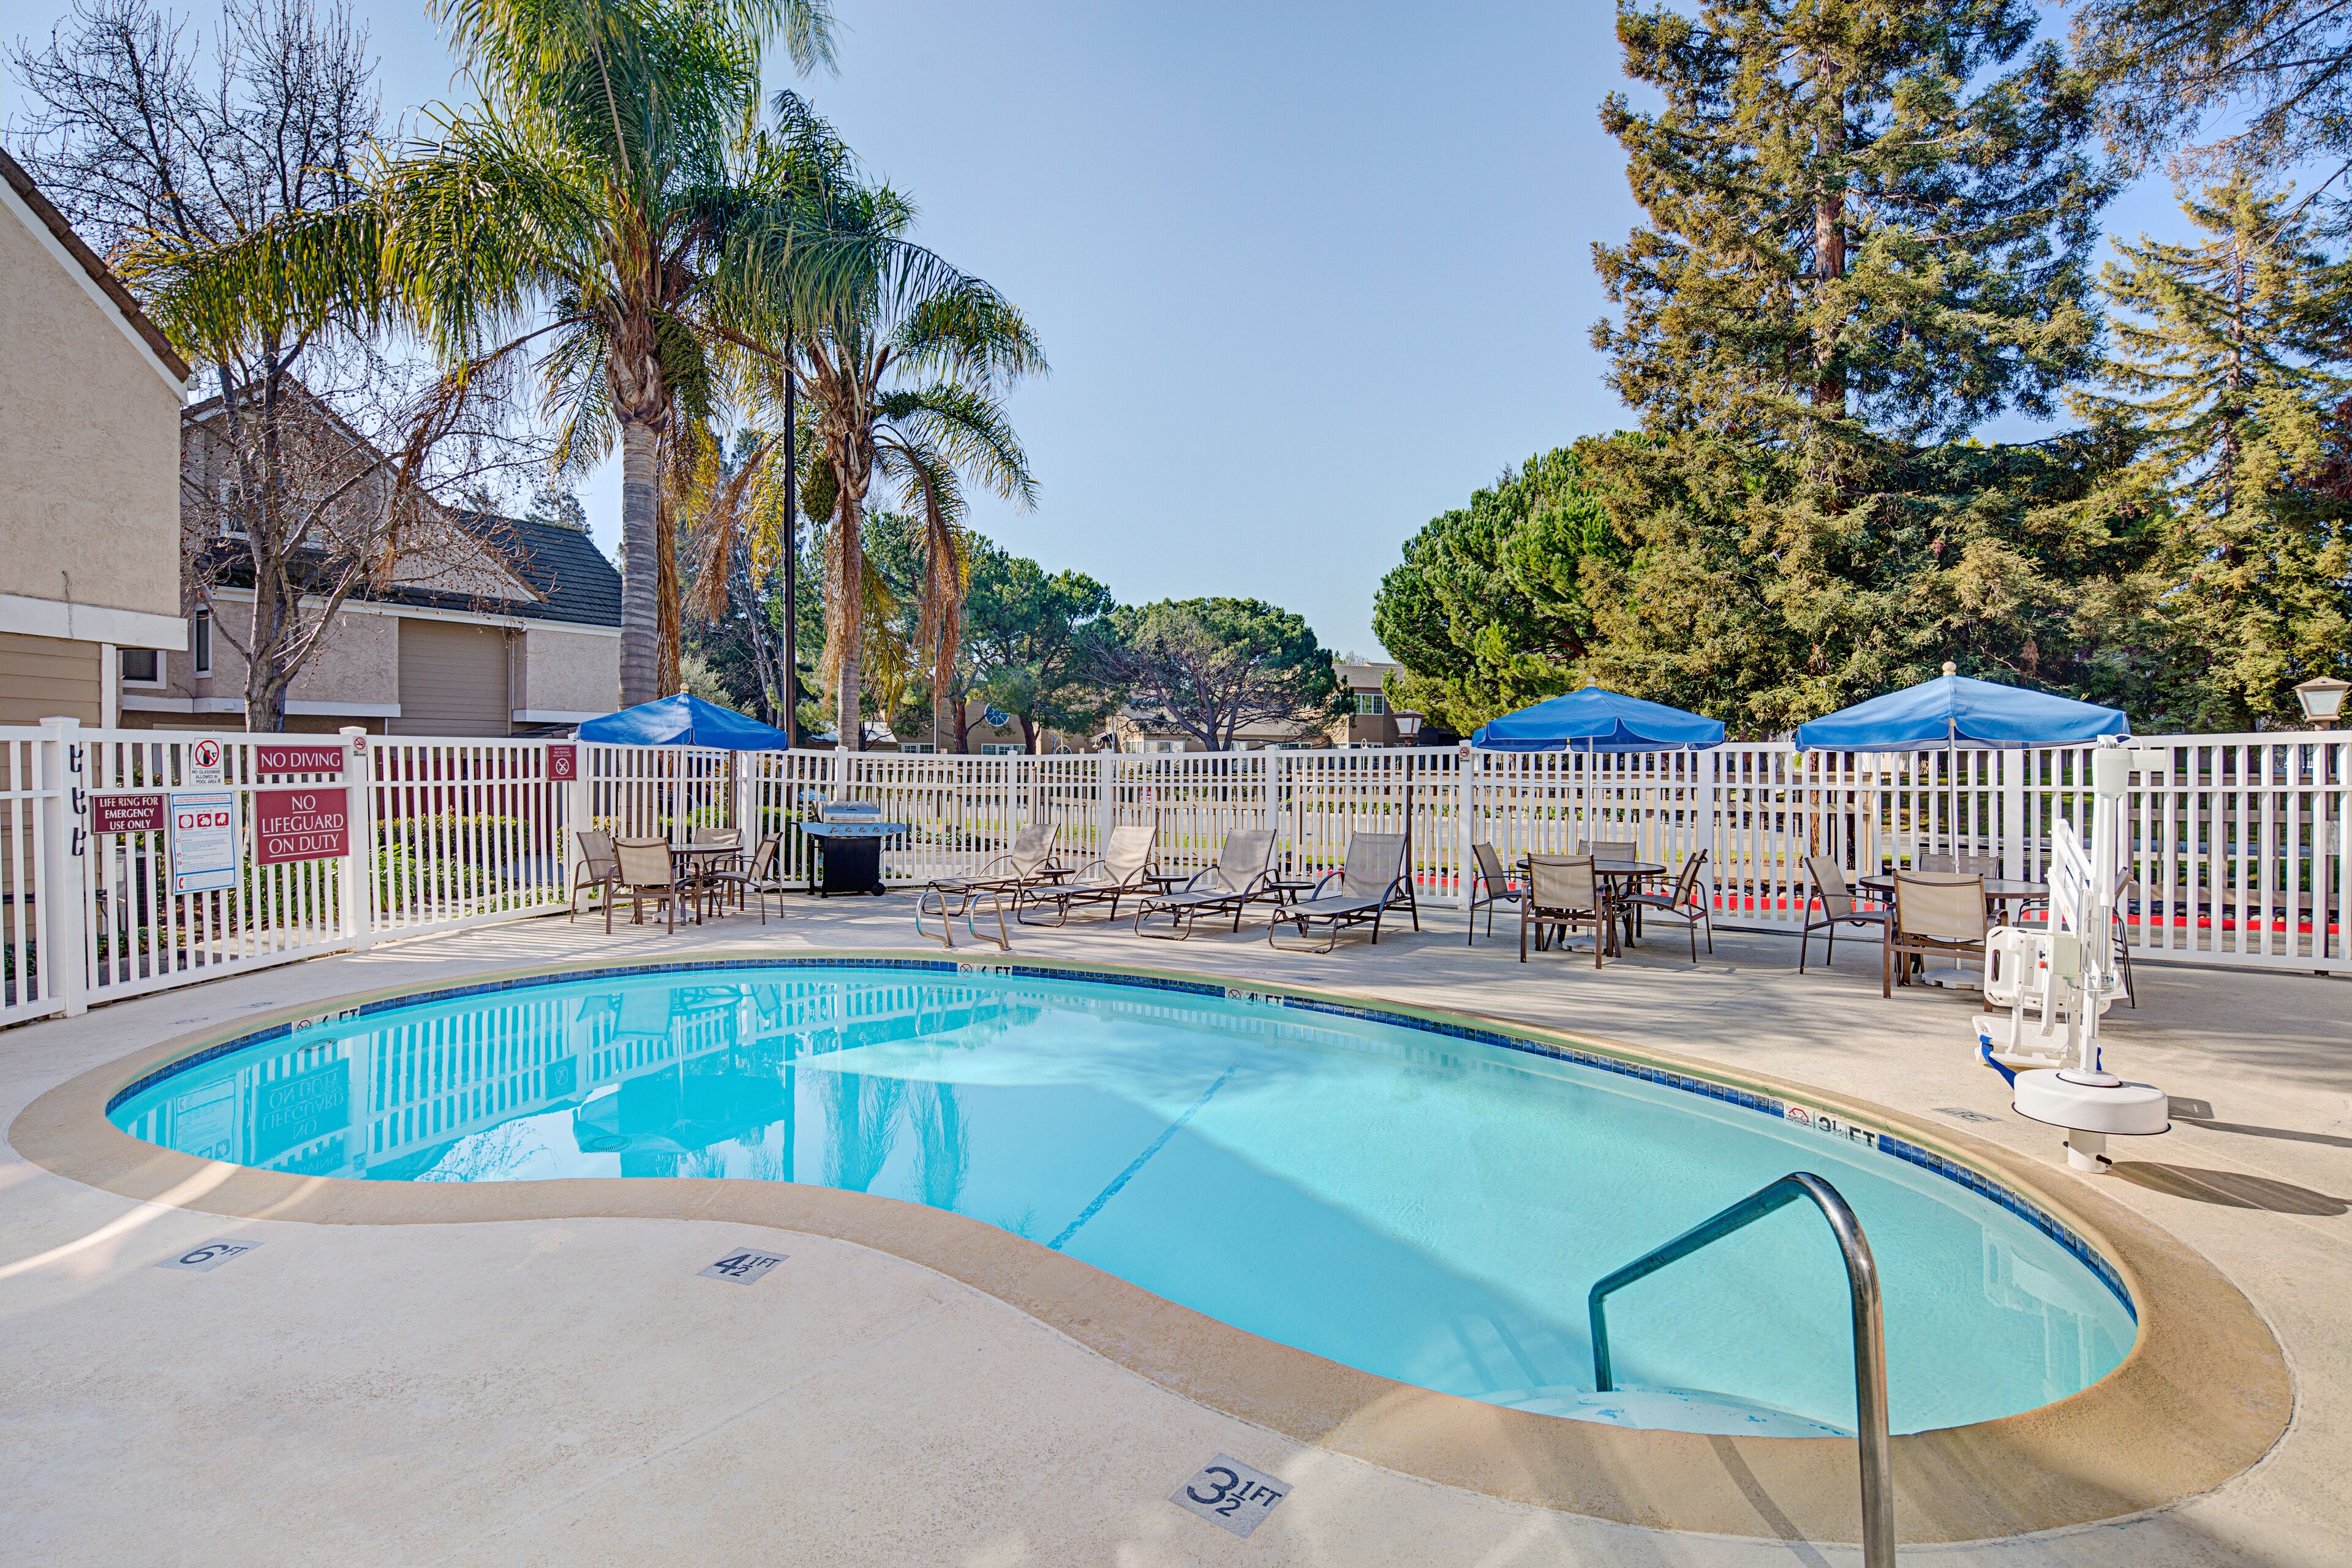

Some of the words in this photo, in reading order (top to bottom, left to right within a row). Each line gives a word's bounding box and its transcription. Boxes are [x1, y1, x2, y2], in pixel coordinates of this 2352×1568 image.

[261, 752, 286, 767] NO
[290, 752, 340, 767] DIVING
[100, 797, 116, 807] LIFE
[118, 797, 140, 807] RING
[142, 796, 159, 806] FOR
[292, 795, 316, 810] NO
[105, 808, 154, 819] EMERGENCY
[110, 821, 125, 831] USE
[127, 820, 151, 829] ONLY
[262, 813, 344, 834] LIFEGUARD
[269, 837, 294, 854] ON
[300, 834, 339, 851] DUTY
[1849, 1126, 1875, 1147] FT
[179, 1244, 229, 1264] 6
[221, 1246, 249, 1256] FT
[757, 1257, 781, 1268] FT
[1249, 1485, 1283, 1507] FT
